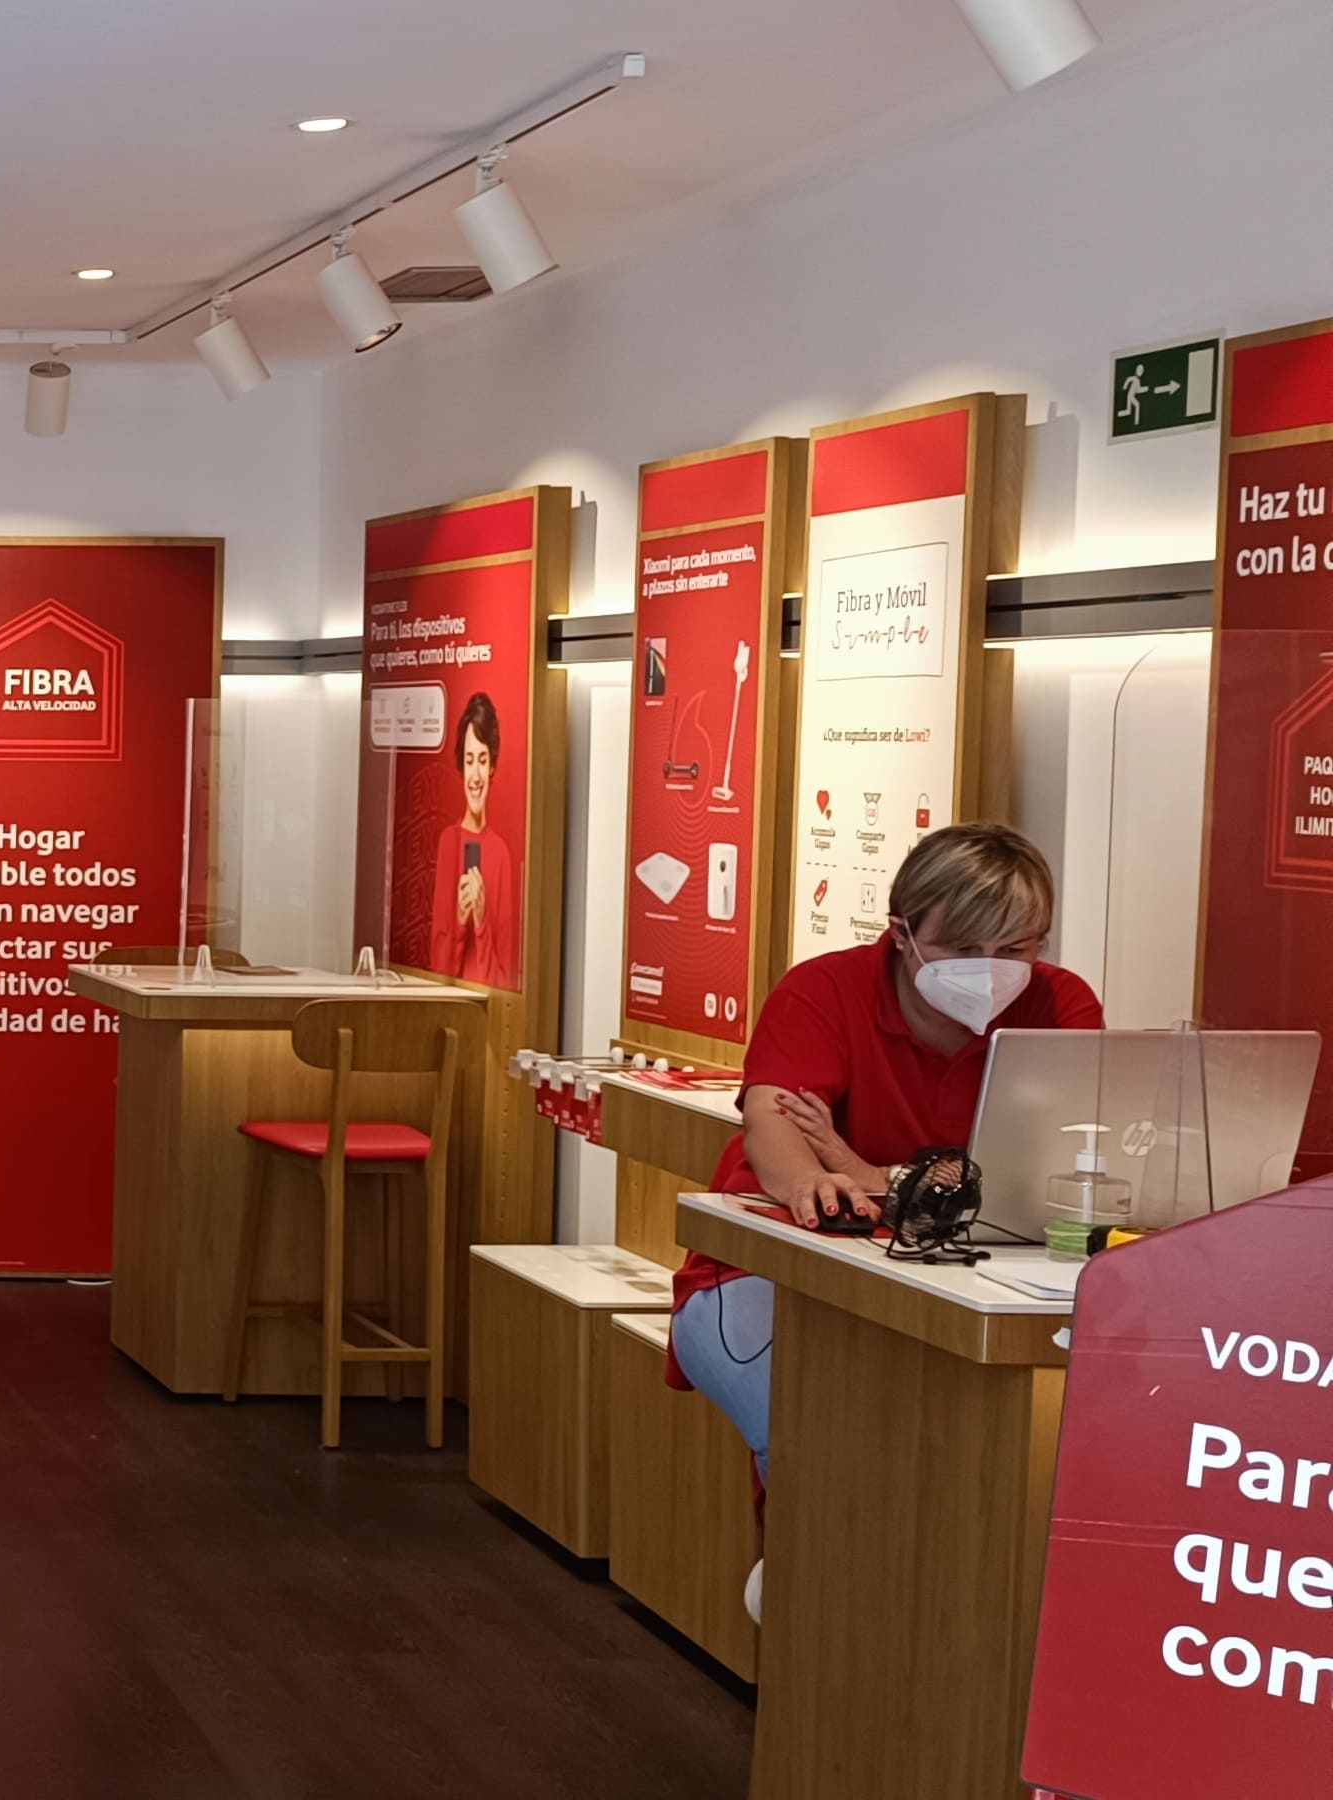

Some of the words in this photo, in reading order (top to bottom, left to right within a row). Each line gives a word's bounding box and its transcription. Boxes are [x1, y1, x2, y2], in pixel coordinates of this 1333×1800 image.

[1239, 485, 1290, 523] Haz
[1296, 482, 1325, 517] tu
[1236, 546, 1284, 577] con
[1292, 535, 1316, 573] la
[837, 590, 871, 613] Fibra
[875, 592, 883, 616] y
[887, 582, 927, 609] Móvil
[371, 622, 389, 641] Para
[399, 618, 412, 639] los
[413, 615, 466, 642] dispositivos
[370, 652, 385, 672] que
[419, 649, 444, 665] como
[445, 641, 455, 664] tú
[456, 640, 492, 668] quieres
[4, 669, 94, 695] FIBRA
[2, 700, 31, 711] ALTA
[32, 700, 96, 711] VELOCIDAD
[880, 730, 892, 742] ser
[893, 728, 904, 742] de
[1309, 786, 1333, 806] HO
[53, 862, 137, 887] todos
[21, 904, 139, 929] navegar
[51, 1008, 86, 1033] de
[1185, 1422, 1333, 1513] Par
